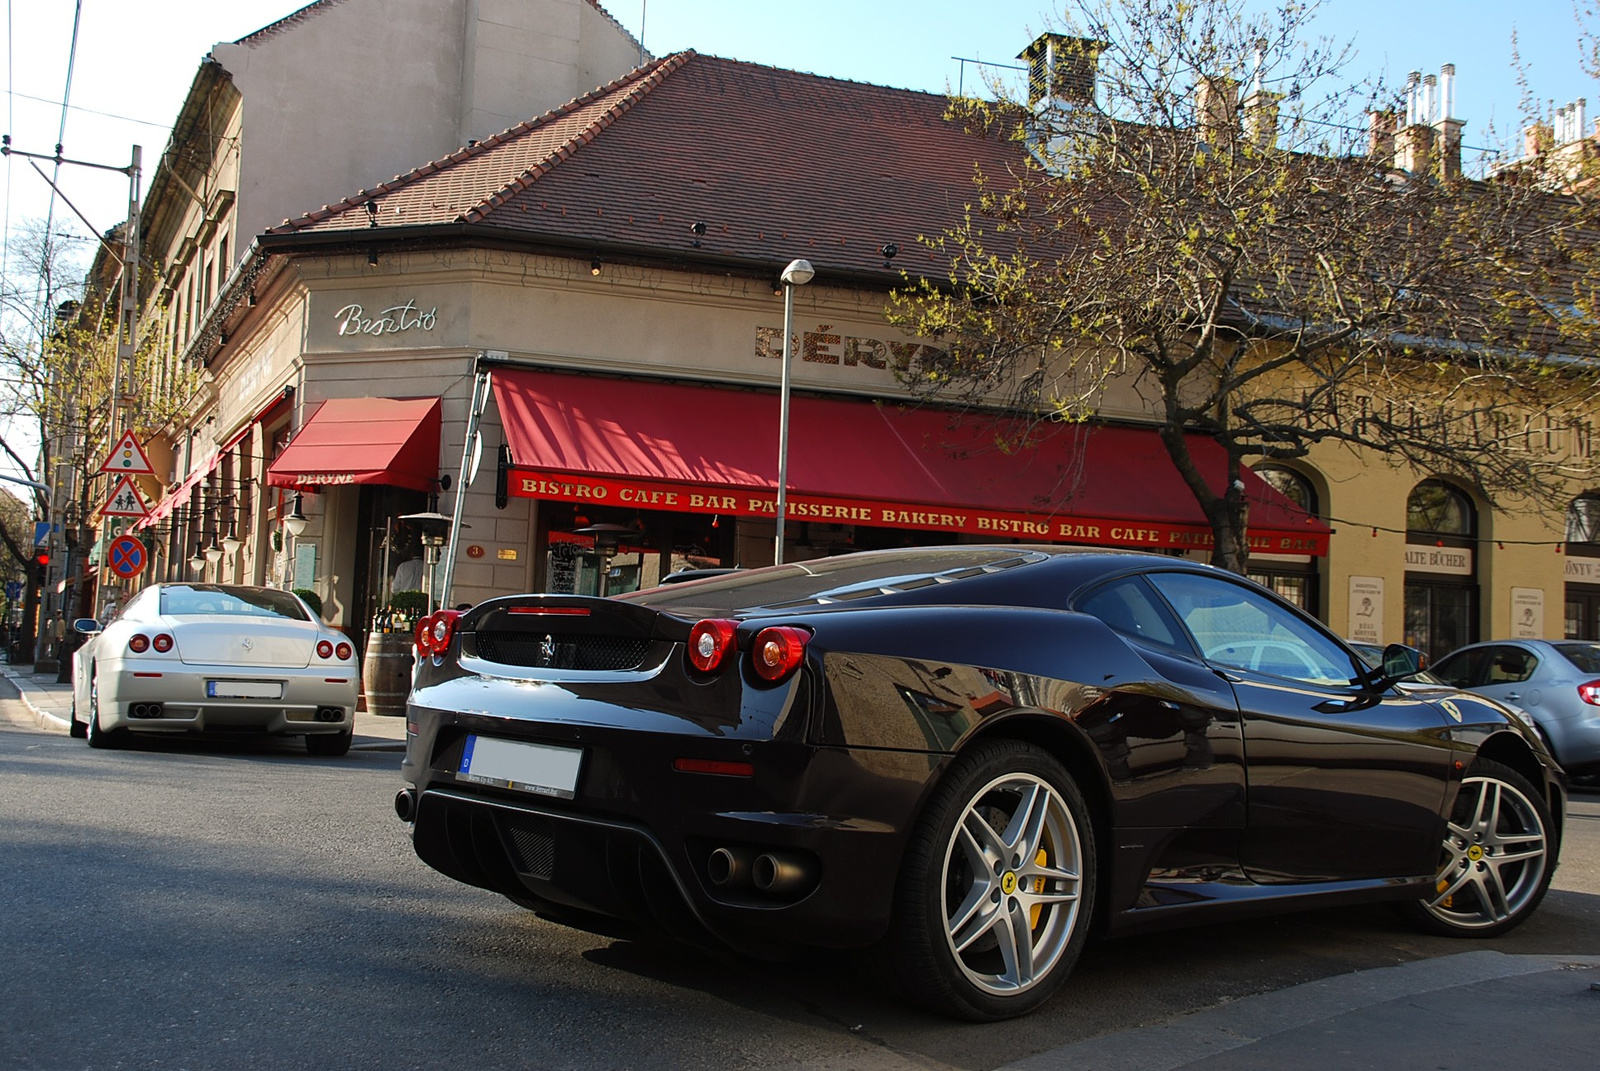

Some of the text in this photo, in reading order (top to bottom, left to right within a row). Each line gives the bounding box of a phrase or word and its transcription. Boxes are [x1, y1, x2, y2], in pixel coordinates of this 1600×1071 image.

[522, 479, 607, 499] BISTRO
[620, 488, 678, 506] CAFE
[690, 494, 737, 510] BAR
[748, 499, 872, 521] PAISSERIE
[882, 509, 966, 528] BAKERY
[978, 517, 1050, 535] BISTRO
[1060, 523, 1100, 539] BAR
[1110, 527, 1159, 542] CAFE
[1279, 538, 1317, 551] BAR
[472, 547, 479, 555] 3
[1404, 551, 1466, 568] ALTE BÜCHER
